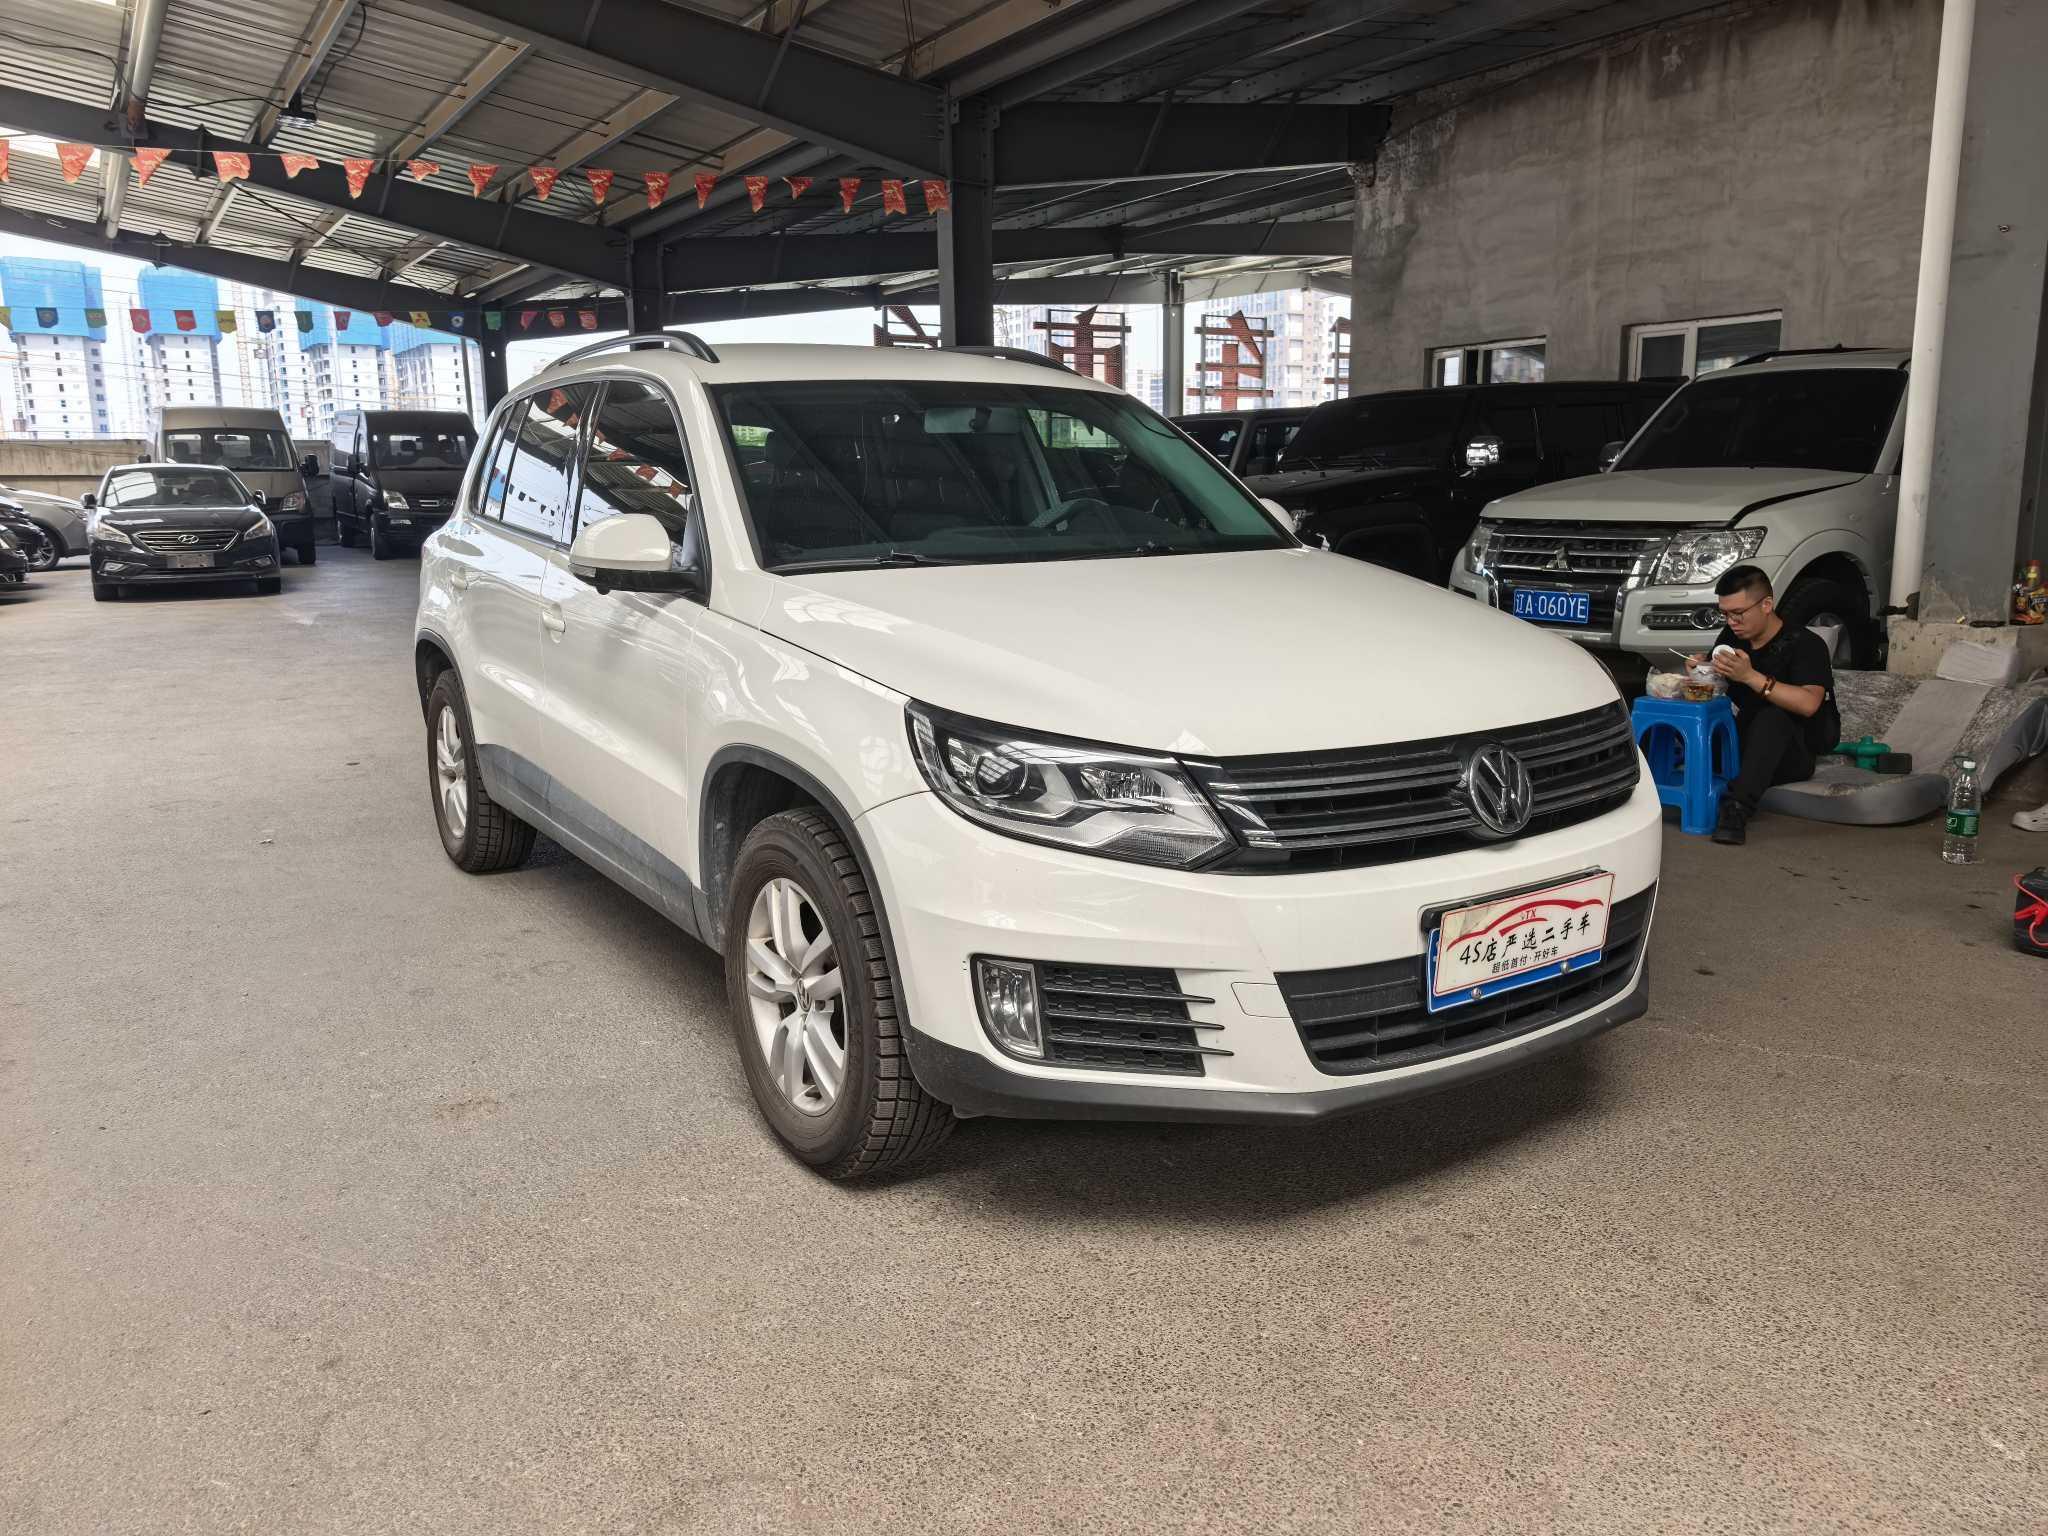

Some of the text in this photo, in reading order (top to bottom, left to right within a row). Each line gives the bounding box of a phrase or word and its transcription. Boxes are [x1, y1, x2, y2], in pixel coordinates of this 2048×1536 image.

[1459, 911, 1591, 965] 4S店严选二手车
